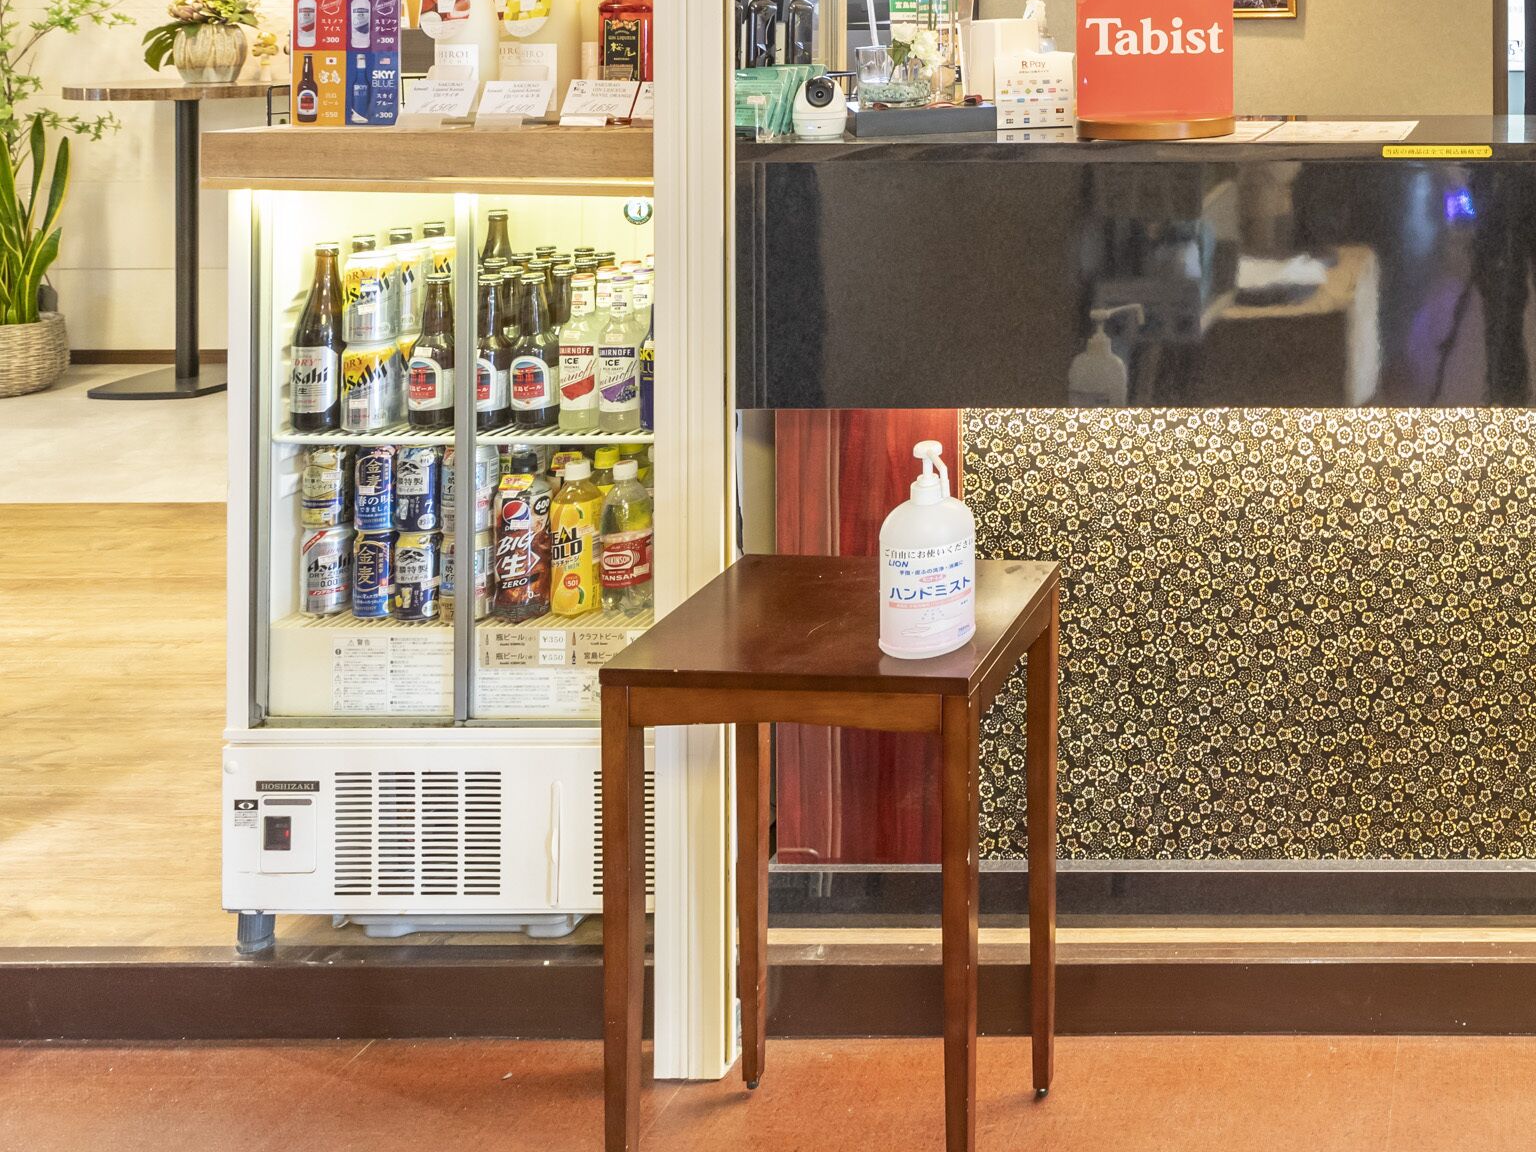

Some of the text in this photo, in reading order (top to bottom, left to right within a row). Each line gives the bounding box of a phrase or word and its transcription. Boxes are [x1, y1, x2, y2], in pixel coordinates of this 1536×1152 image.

[1085, 16, 1225, 56] Tabist
[1029, 60, 1046, 70] Pay
[372, 71, 396, 80] SKYY
[372, 79, 395, 88] BLUE
[295, 359, 314, 367] DRY
[605, 359, 620, 367] ICE
[535, 499, 549, 510] 600
[552, 527, 577, 546] EAL
[498, 532, 536, 556] BIG
[357, 546, 376, 585] 金麦
[500, 553, 527, 579] 生
[889, 560, 909, 568] LION
[502, 578, 528, 589] ZERO
[890, 576, 971, 600] ハンドミスト
[542, 636, 564, 644] ¥350
[579, 633, 624, 641] クラフトビール
